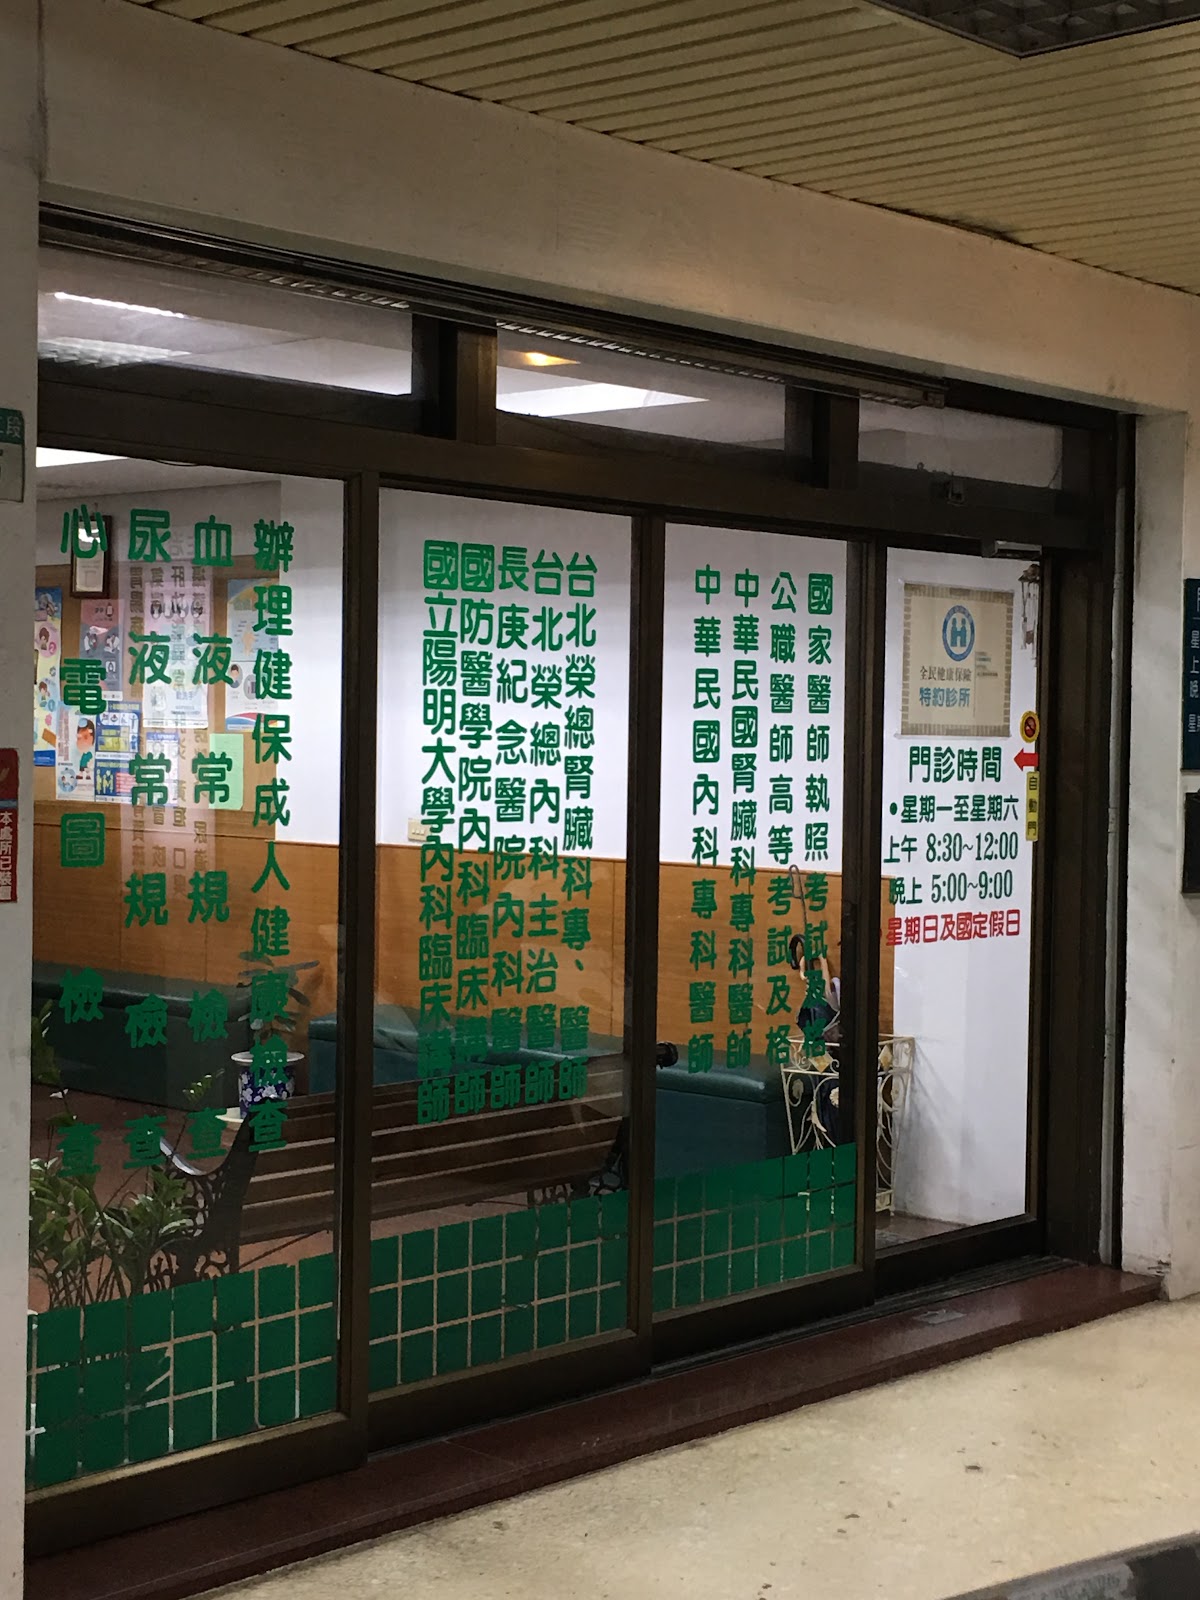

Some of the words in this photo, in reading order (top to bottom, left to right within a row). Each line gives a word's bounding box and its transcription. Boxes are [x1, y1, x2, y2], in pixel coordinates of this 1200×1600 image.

[58, 504, 109, 1177] 心電圖檢查
[124, 508, 173, 1169] 尿液常規檢查
[187, 516, 236, 1160] 血液常規檢查
[249, 519, 294, 1153] 辦理健保成人健康檢查
[490, 545, 530, 1110] 長庚紀念醫院內科醫師
[525, 549, 564, 1105] 台北榮總內科主治醫師
[686, 564, 722, 1074] 中華民國內科專科醫師
[726, 568, 760, 1069] 中華民國腎臟科專科醫師
[766, 572, 798, 1066] 公職醫師高等考試及格
[802, 573, 834, 1058] 國家醫師執照考試及格
[883, 834, 918, 864] 上午
[925, 831, 1019, 863] 8:30~12:00
[889, 876, 923, 906] 晚上
[931, 869, 1014, 904] 5:00~9:00
[900, 794, 1020, 823] 星期一至星期六
[908, 746, 1003, 783] 門診時間
[919, 687, 971, 708] 特約診所
[920, 665, 972, 682] 全民健康保險
[1027, 776, 1038, 836] 自動門
[886, 909, 1021, 946] 星期日及國定假日
